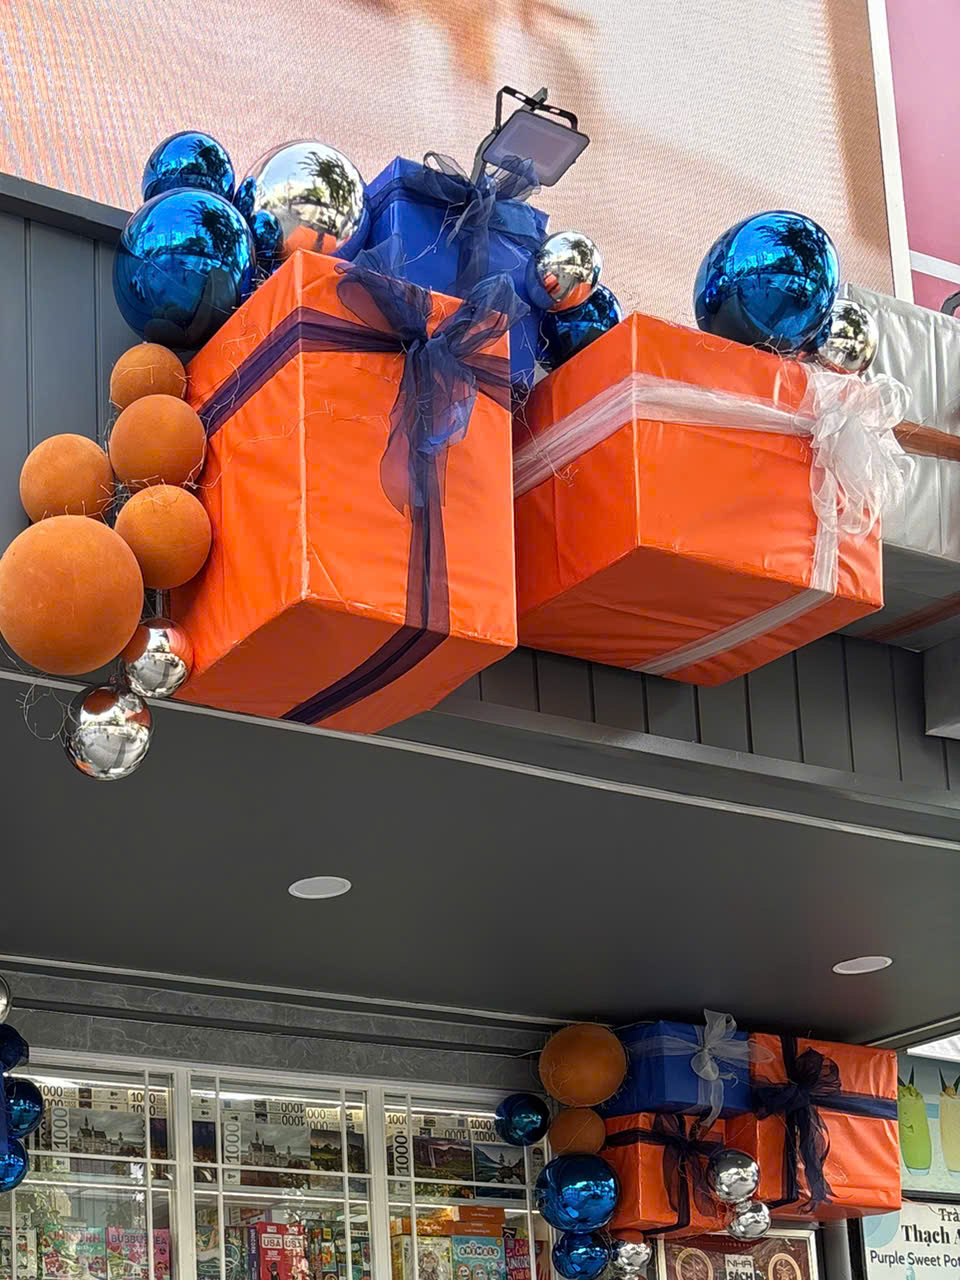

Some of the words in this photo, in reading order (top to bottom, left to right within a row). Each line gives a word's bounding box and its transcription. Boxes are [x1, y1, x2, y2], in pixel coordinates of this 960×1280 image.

[224, 1122, 239, 1163] 1000
[395, 1135, 409, 1173] 1000
[938, 1208, 960, 1223] Trà
[263, 1238, 281, 1247] USA
[900, 1224, 951, 1247] Thạch
[870, 1250, 906, 1269] Purple
[907, 1252, 942, 1267] Sweet
